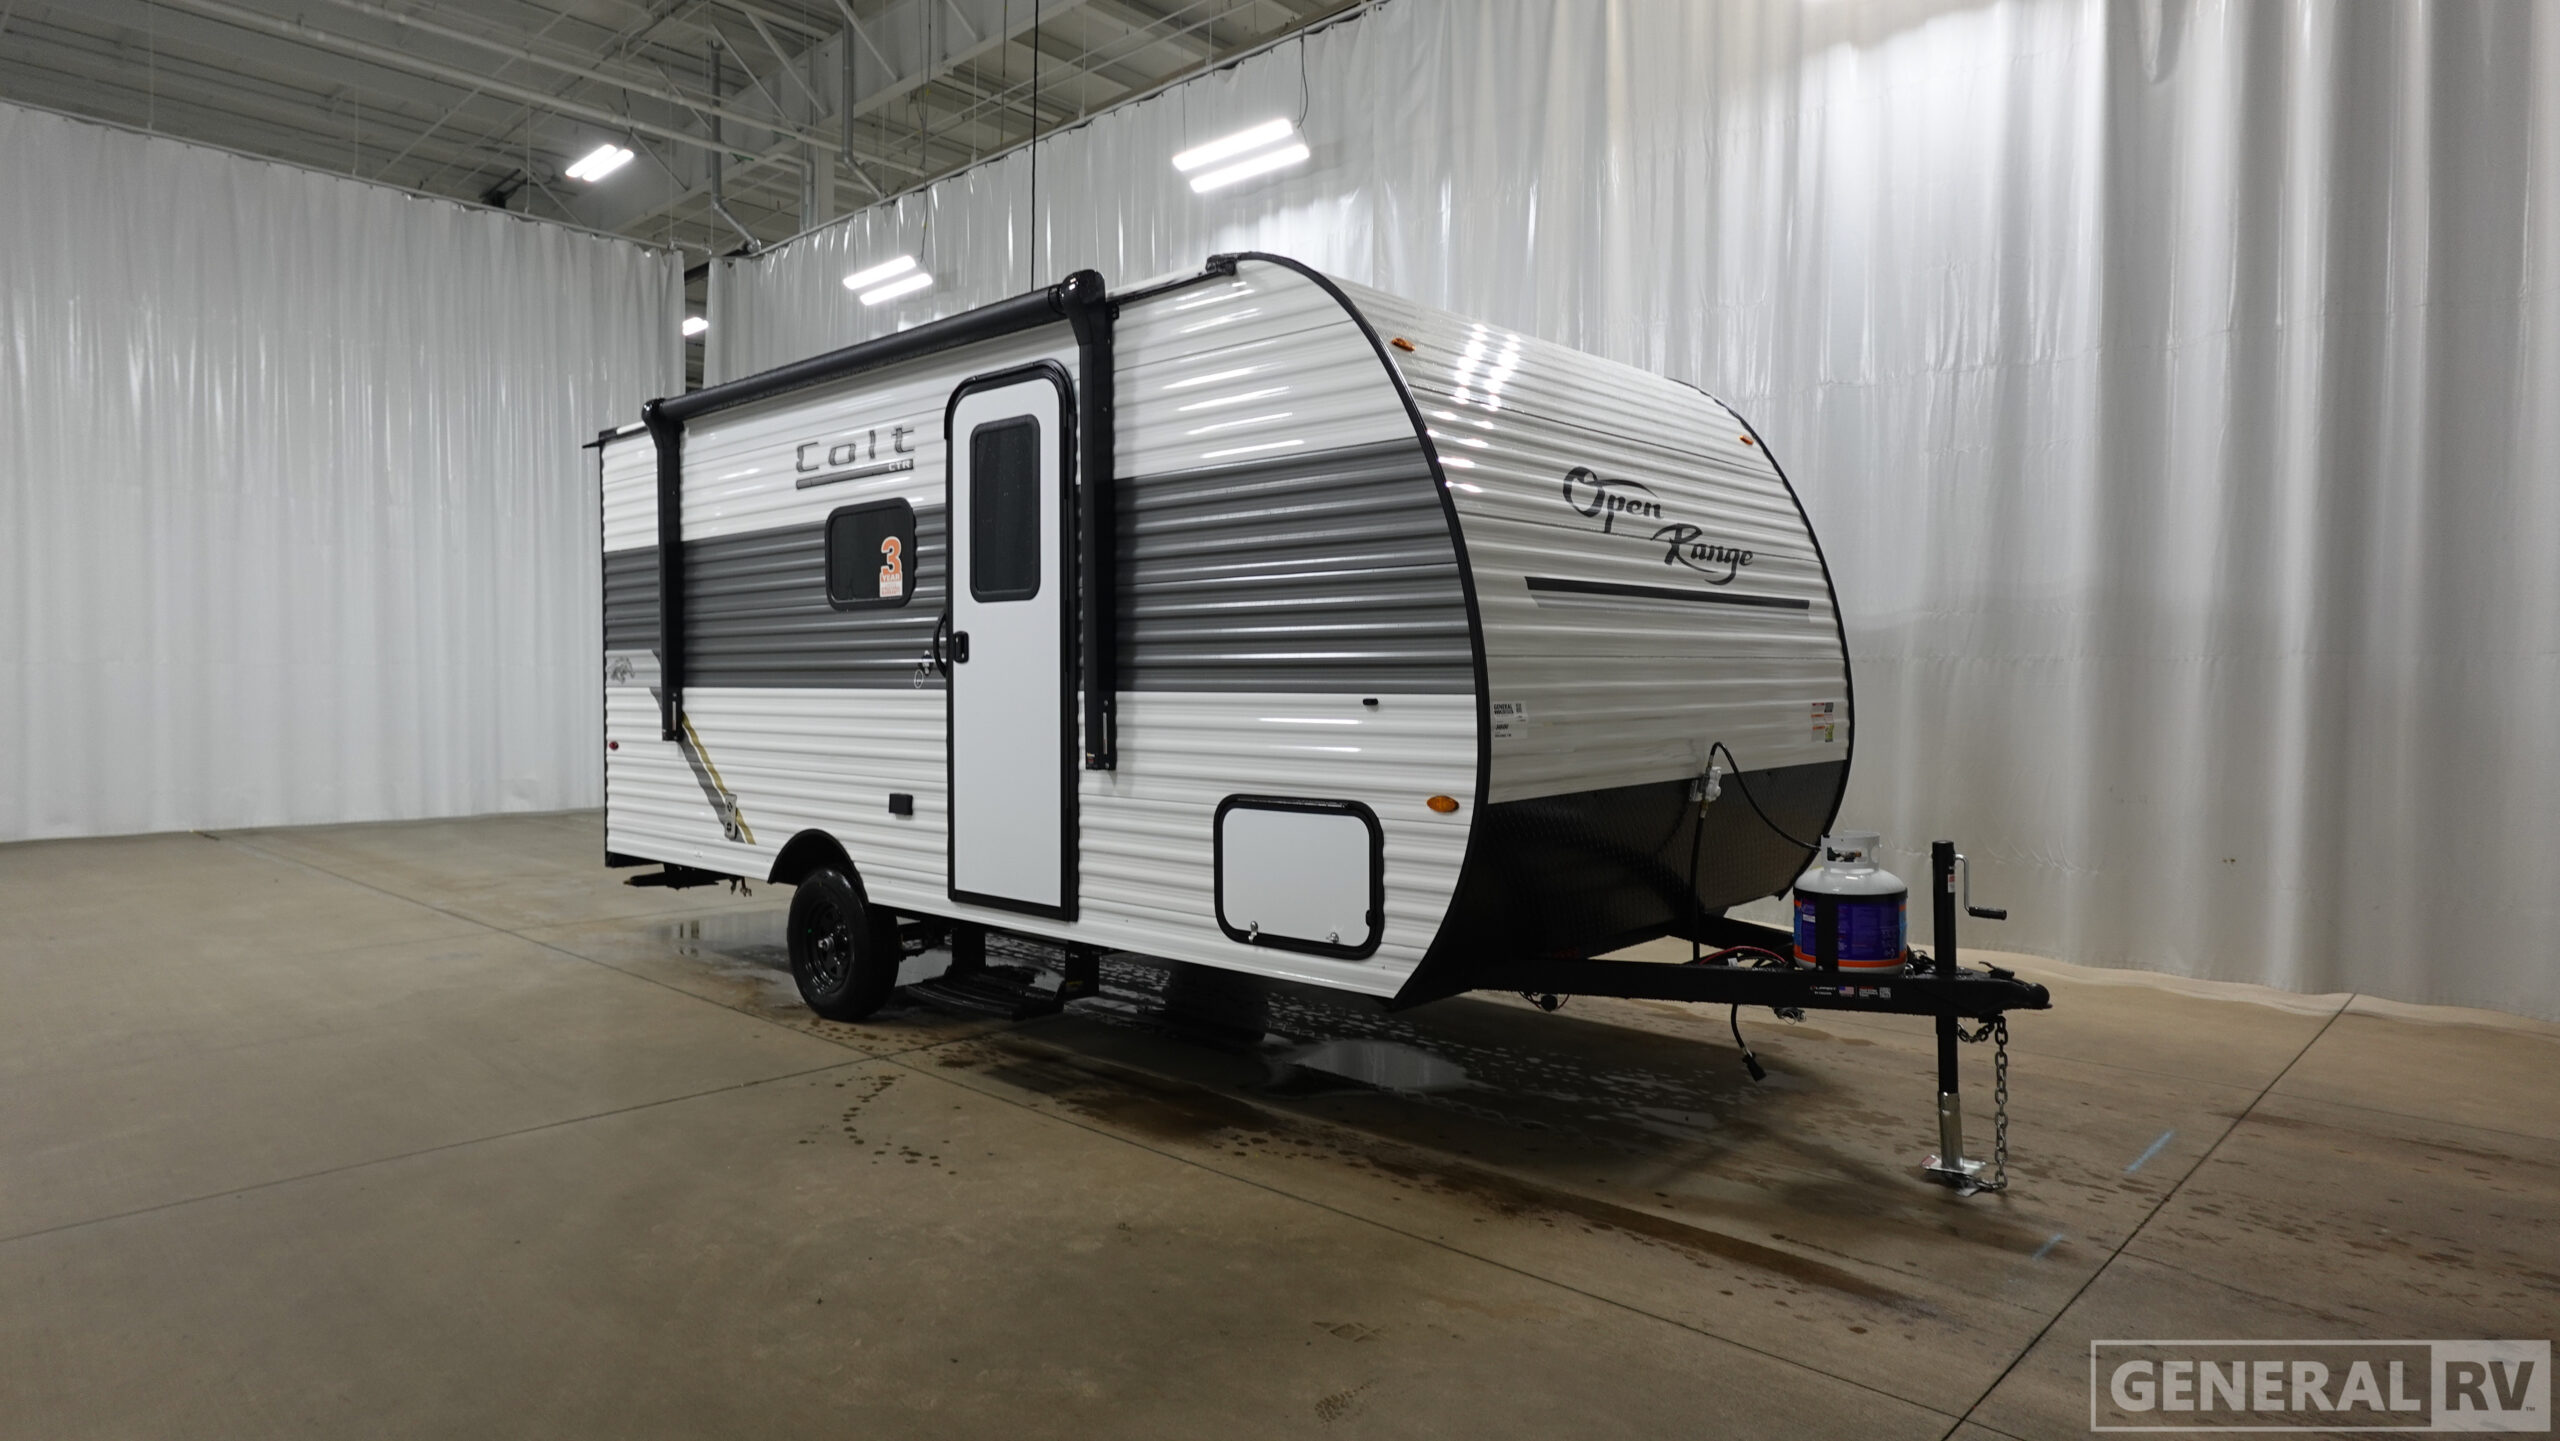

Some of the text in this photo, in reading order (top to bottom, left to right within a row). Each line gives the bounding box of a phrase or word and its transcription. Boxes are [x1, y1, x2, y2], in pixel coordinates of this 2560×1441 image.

[796, 427, 915, 473] Colt
[888, 460, 911, 471] CTR
[1562, 466, 1664, 534] Open
[881, 536, 902, 574] 3
[1651, 522, 1754, 586] Range
[882, 573, 901, 583] YEAR
